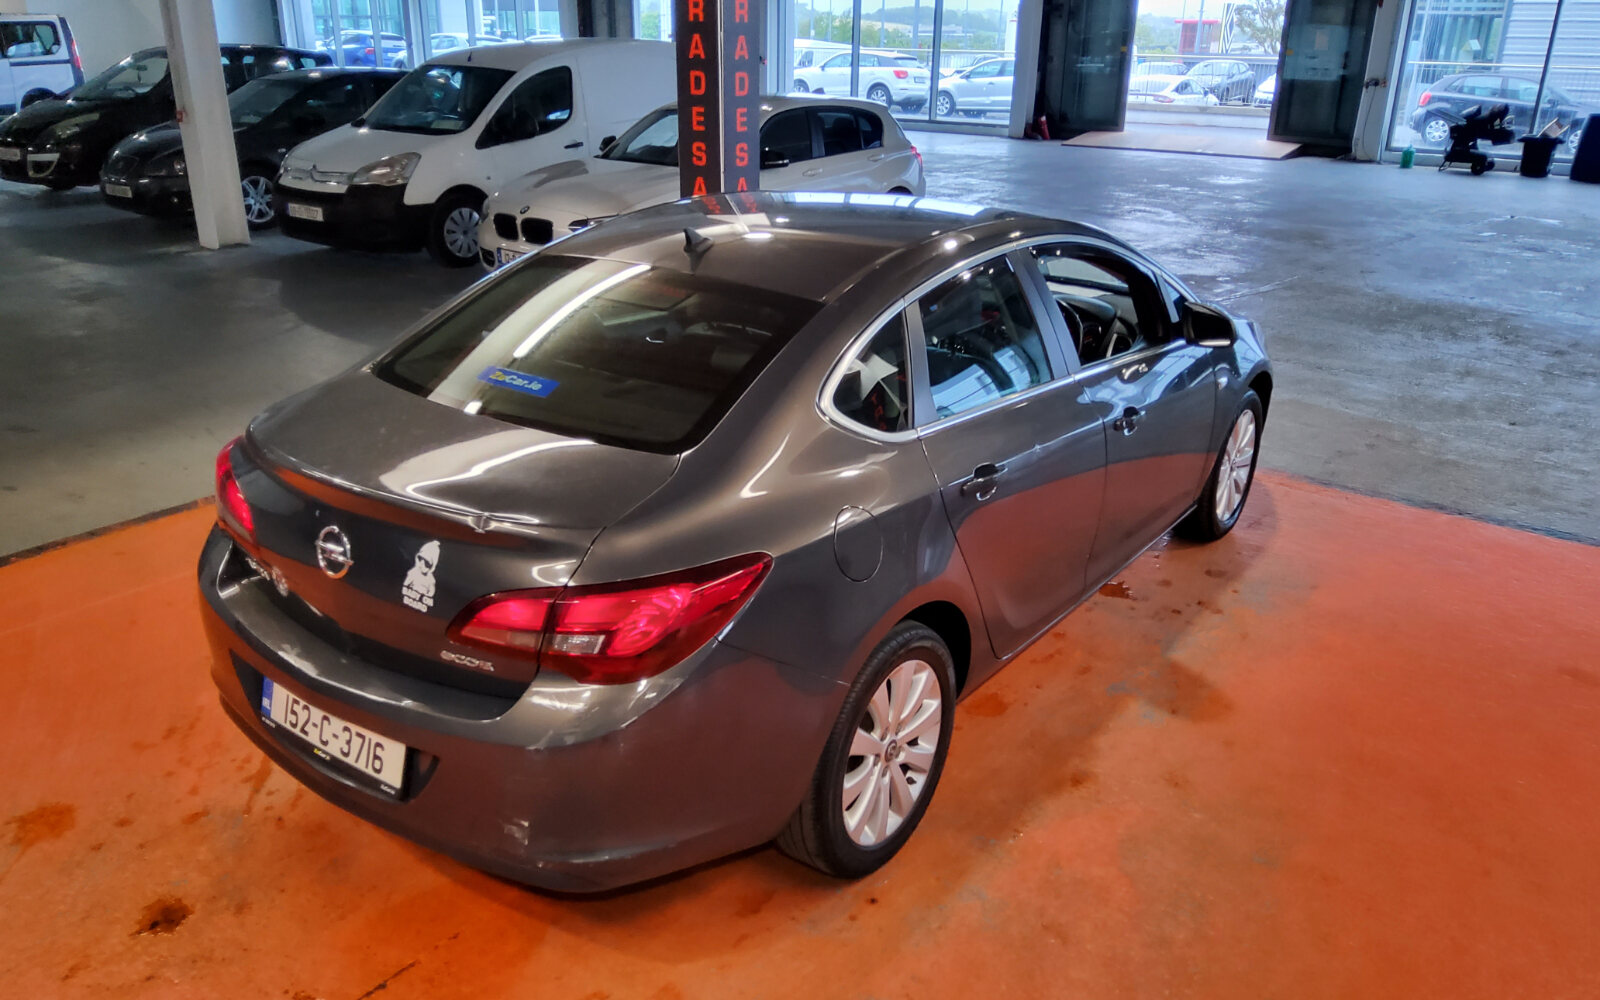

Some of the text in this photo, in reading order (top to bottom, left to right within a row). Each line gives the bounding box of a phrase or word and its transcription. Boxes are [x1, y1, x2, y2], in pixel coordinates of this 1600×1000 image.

[402, 586, 434, 607] BABY ON
[403, 595, 428, 613] BOARD
[284, 694, 385, 774] 152-C-3716
